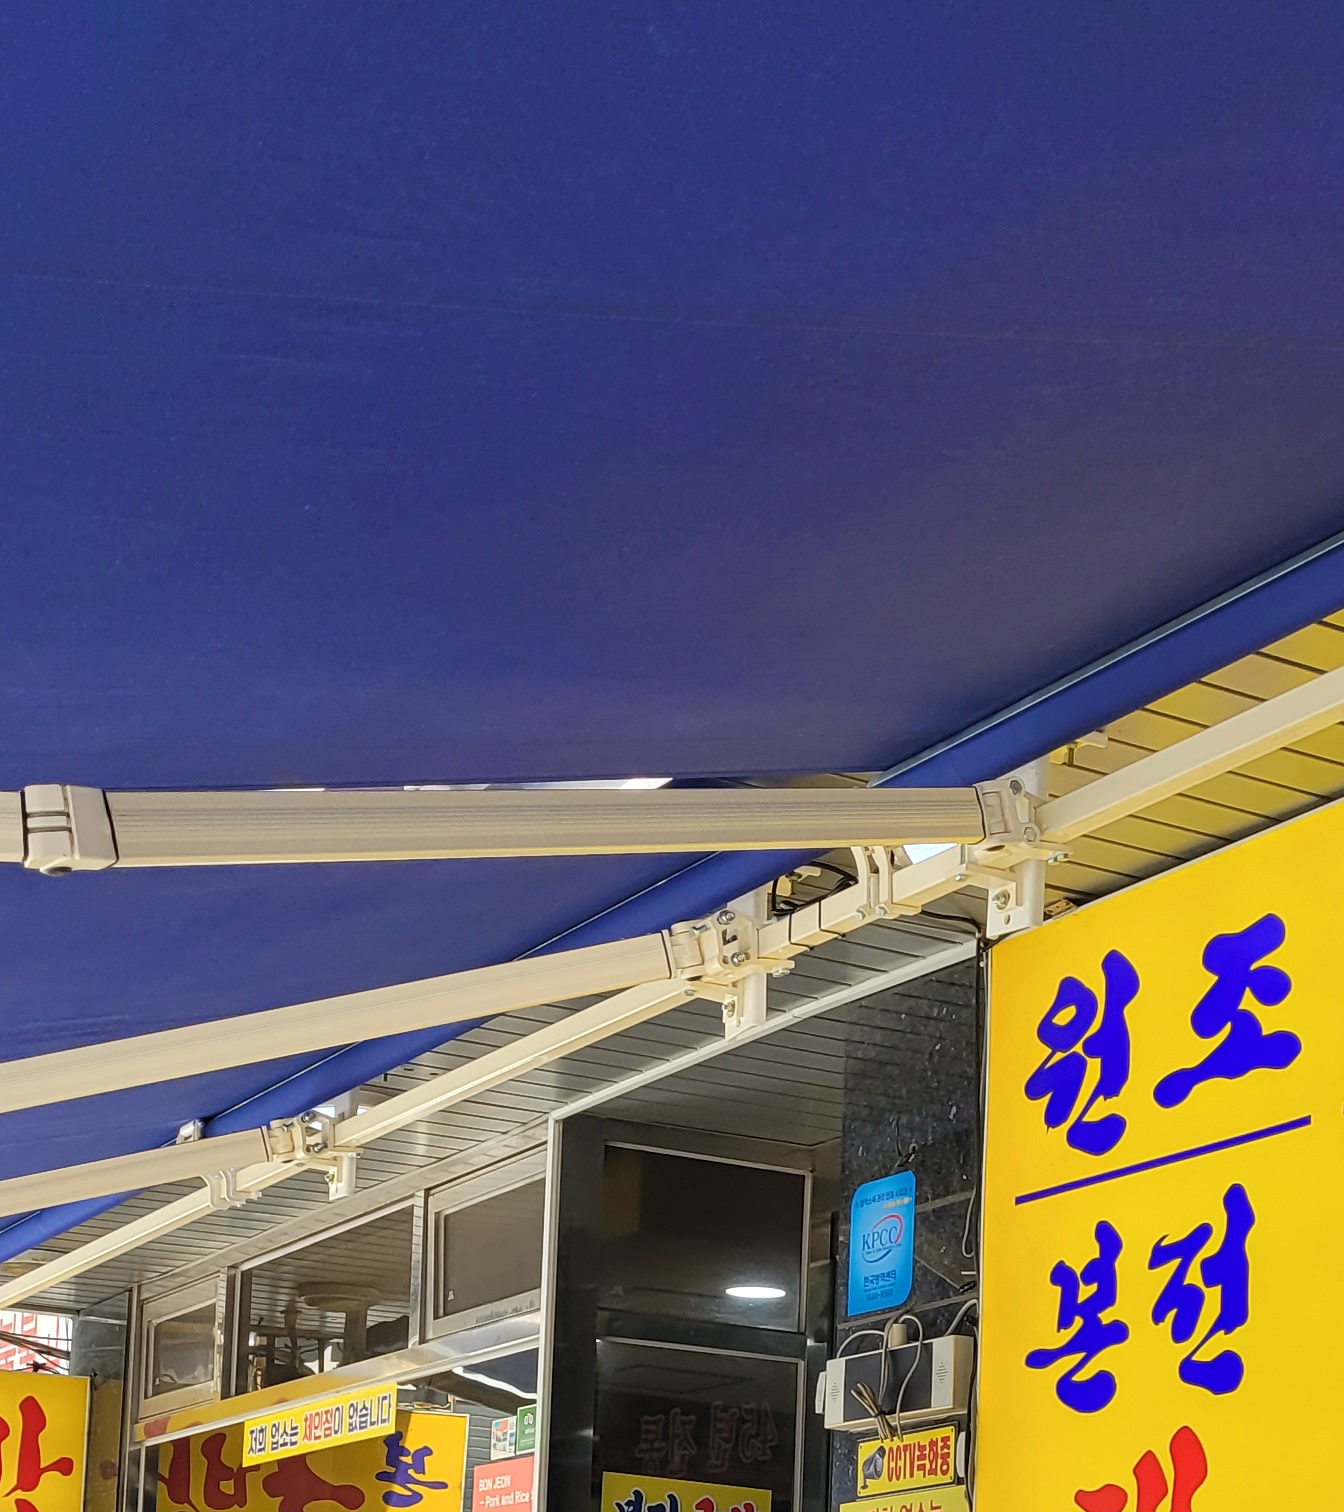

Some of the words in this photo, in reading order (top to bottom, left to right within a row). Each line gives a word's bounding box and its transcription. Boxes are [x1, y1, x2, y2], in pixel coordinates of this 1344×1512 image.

[1023, 912, 1303, 1157] 원조
[862, 1226, 898, 1251] KPCC
[1024, 1182, 1258, 1413] 본전
[248, 1425, 267, 1455] 저희
[271, 1418, 299, 1450] 업소는
[348, 1393, 392, 1433] 없습니다
[887, 1435, 951, 1482] CCTV녹화중
[478, 1479, 492, 1493] BON
[493, 1475, 511, 1490] JEON
[485, 1494, 500, 1508] Pork
[501, 1492, 514, 1505] and
[515, 1490, 530, 1504] Rice
